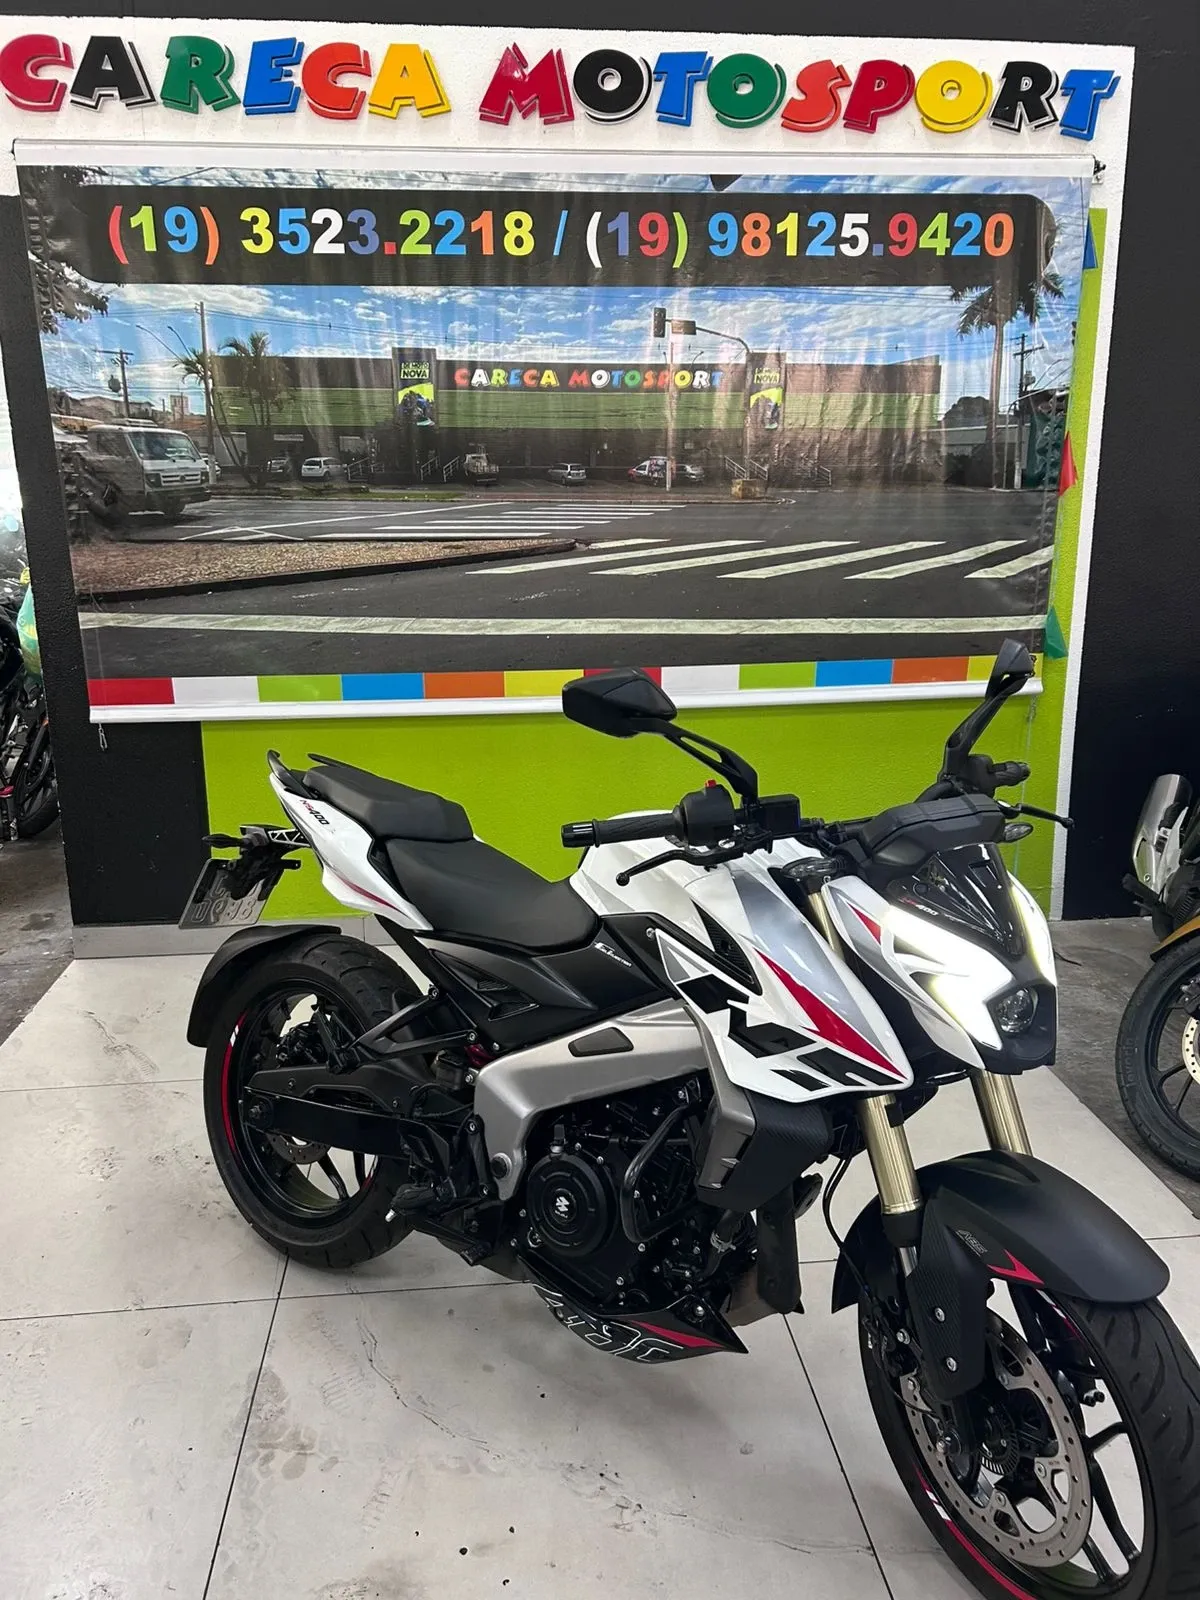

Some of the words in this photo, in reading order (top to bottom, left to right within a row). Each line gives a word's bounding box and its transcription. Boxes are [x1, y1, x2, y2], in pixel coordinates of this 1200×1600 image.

[0, 34, 452, 120] CARECA
[479, 43, 1121, 141] MOTOSPORT
[109, 204, 220, 265] (19)
[240, 207, 535, 256] 3523.2218
[586, 211, 688, 268] (19)
[708, 211, 1014, 257] 98125.9420
[402, 370, 428, 378] NOVA
[454, 368, 560, 388] CARECA
[568, 369, 723, 389] MOTOSPORT
